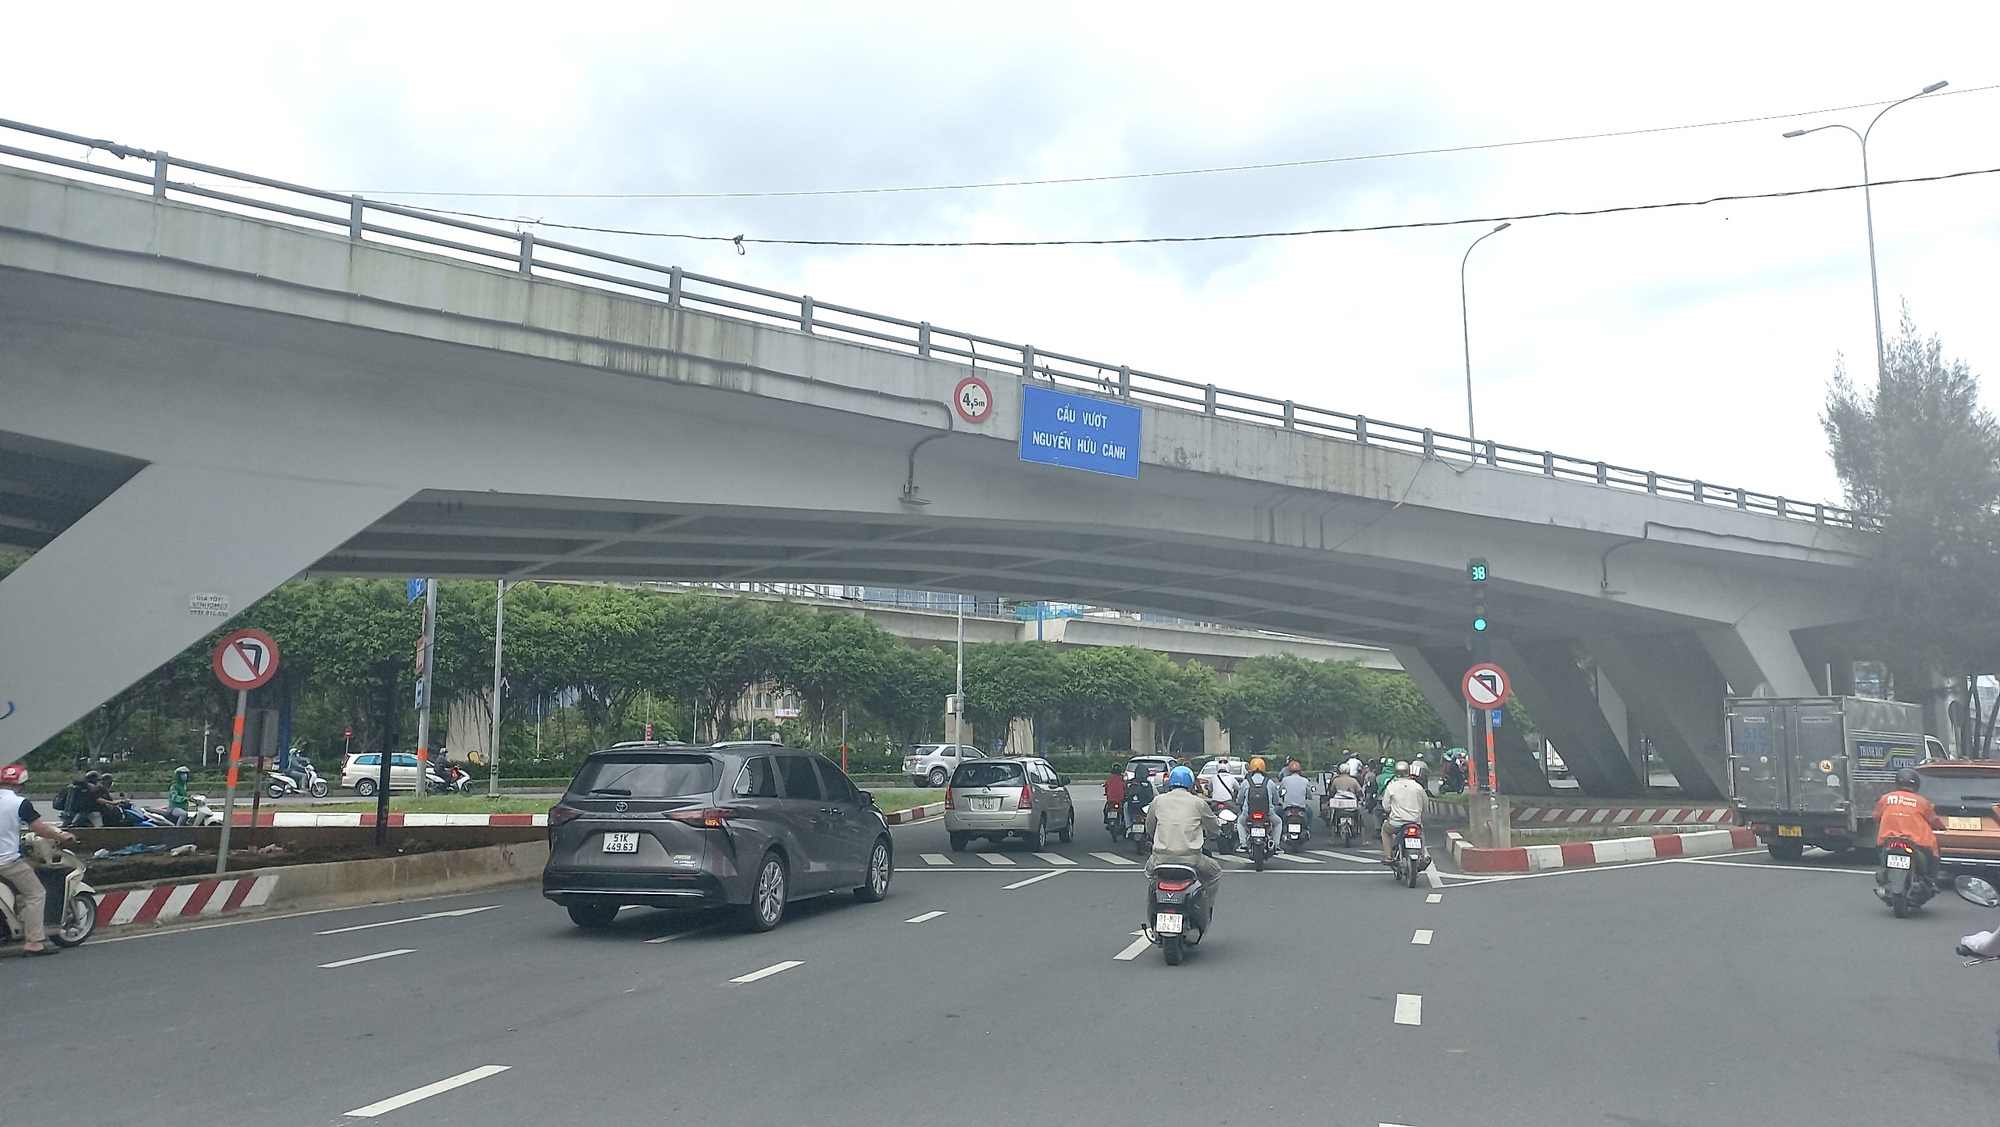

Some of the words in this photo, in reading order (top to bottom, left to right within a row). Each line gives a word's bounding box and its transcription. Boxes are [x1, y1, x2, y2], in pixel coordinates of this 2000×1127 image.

[1057, 403, 1076, 423] CẦU
[1082, 411, 1108, 431] VƯỢT
[1032, 430, 1072, 451] NGUYỄN
[1077, 435, 1097, 455] HỮU
[1102, 440, 1126, 460] CẢNH
[1472, 566, 1486, 581] 38
[1899, 799, 1917, 808] Food
[613, 833, 629, 843] 51K
[606, 842, 634, 851] 449.63
